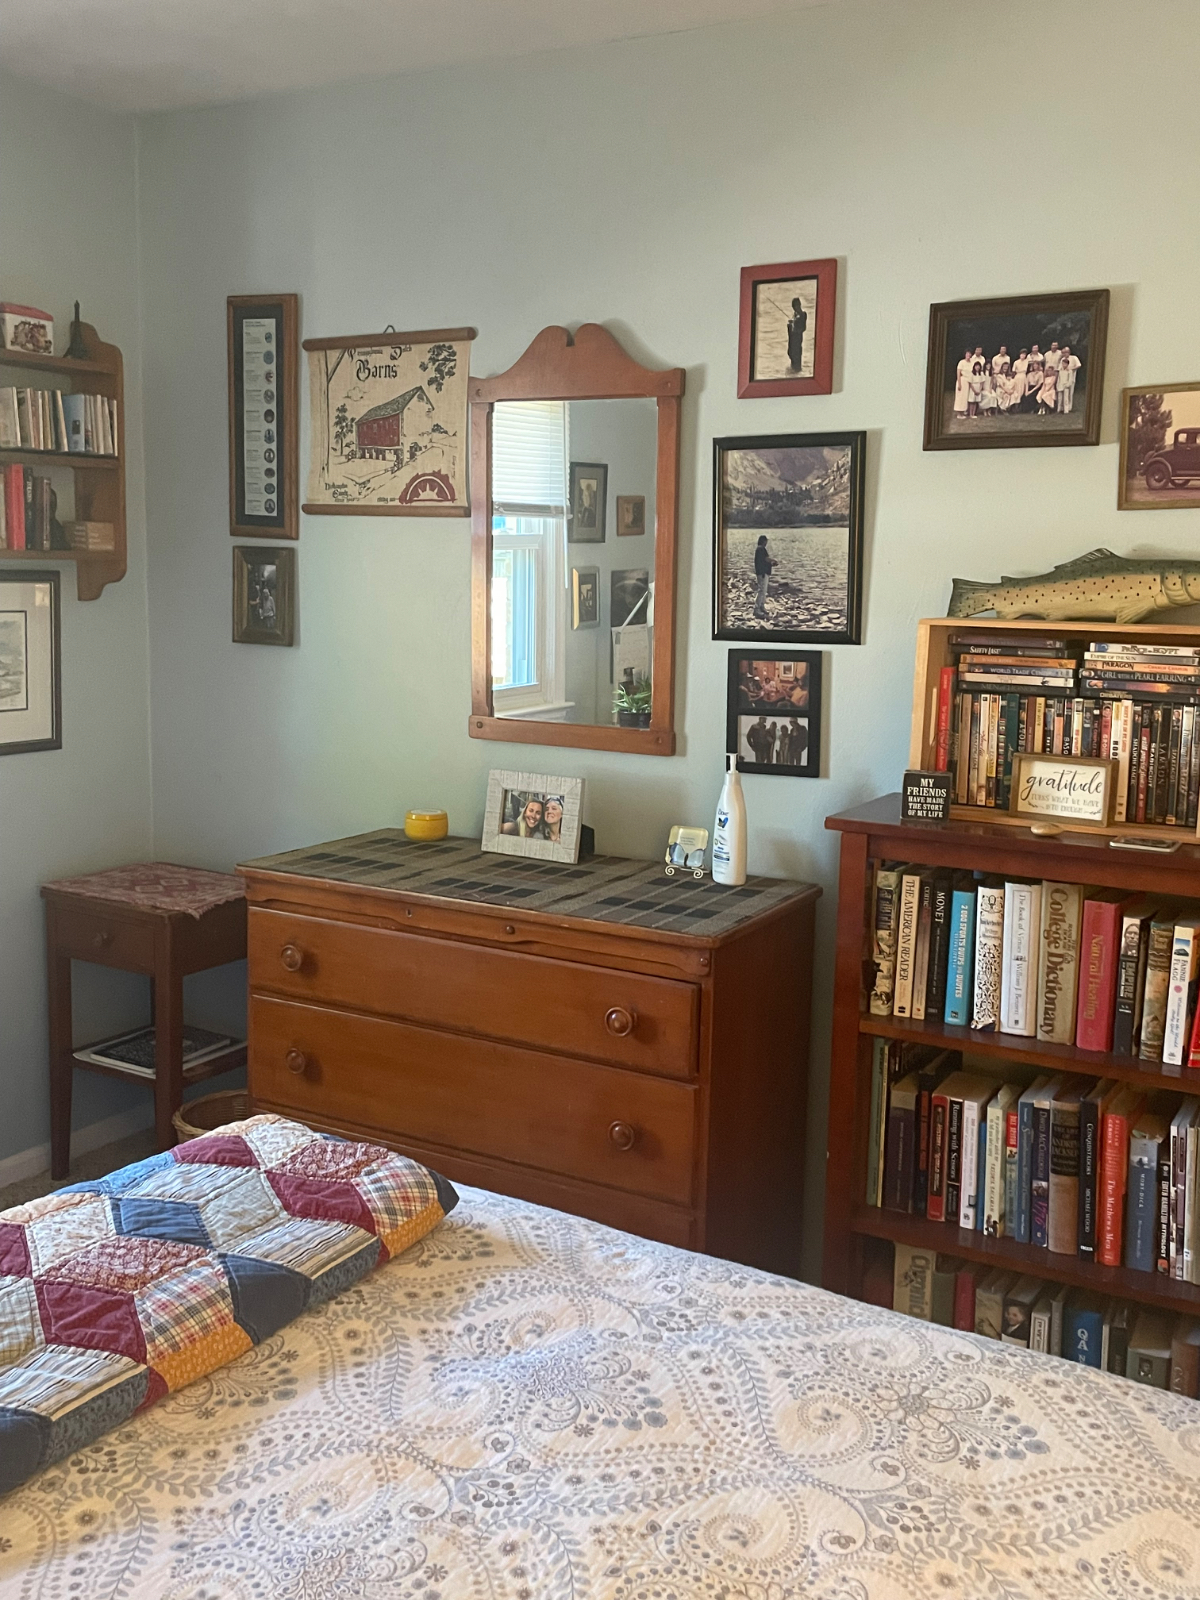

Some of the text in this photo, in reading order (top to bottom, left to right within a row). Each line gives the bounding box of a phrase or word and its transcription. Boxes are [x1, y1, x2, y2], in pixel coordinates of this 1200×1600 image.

[356, 359, 398, 382] Barns
[1135, 672, 1154, 680] PEARL
[1156, 673, 1187, 682] EARRING
[1148, 743, 1156, 788] SEABISCUIT
[1157, 743, 1166, 785] SAMSON
[1170, 749, 1178, 783] SPARTACUS
[907, 787, 947, 797] FRIENDS
[920, 778, 934, 787] MY
[1020, 769, 1102, 800] gratitude
[927, 797, 945, 805] MADE
[935, 891, 945, 924] MONET
[899, 880, 915, 981] THE AMERICAN READER
[958, 922, 967, 946] SPORTS
[1017, 894, 1026, 954] The Book of Virtues
[957, 947, 966, 966] QUIPS
[1039, 887, 1068, 1038] College Dictionary
[1014, 963, 1023, 987] William
[1084, 934, 1104, 1021] Natural Healing
[1124, 962, 1136, 998] EMPIRE
[1172, 959, 1181, 981] FLAGG
[1180, 959, 1189, 982] FANNIE
[955, 974, 964, 999] QUOTES
[1014, 993, 1022, 1016] Bennett
[1039, 1111, 1047, 1132] DAVID
[950, 1104, 960, 1179] Running with Scissors
[1085, 1123, 1093, 1176] CONQUISTADORS
[1161, 1181, 1169, 1196] EDITH
[1033, 1201, 1047, 1229] 1776
[1106, 1196, 1115, 1230] Mathews
[1160, 1197, 1169, 1223] HAMILTON
[1105, 1232, 1114, 1250] Men
